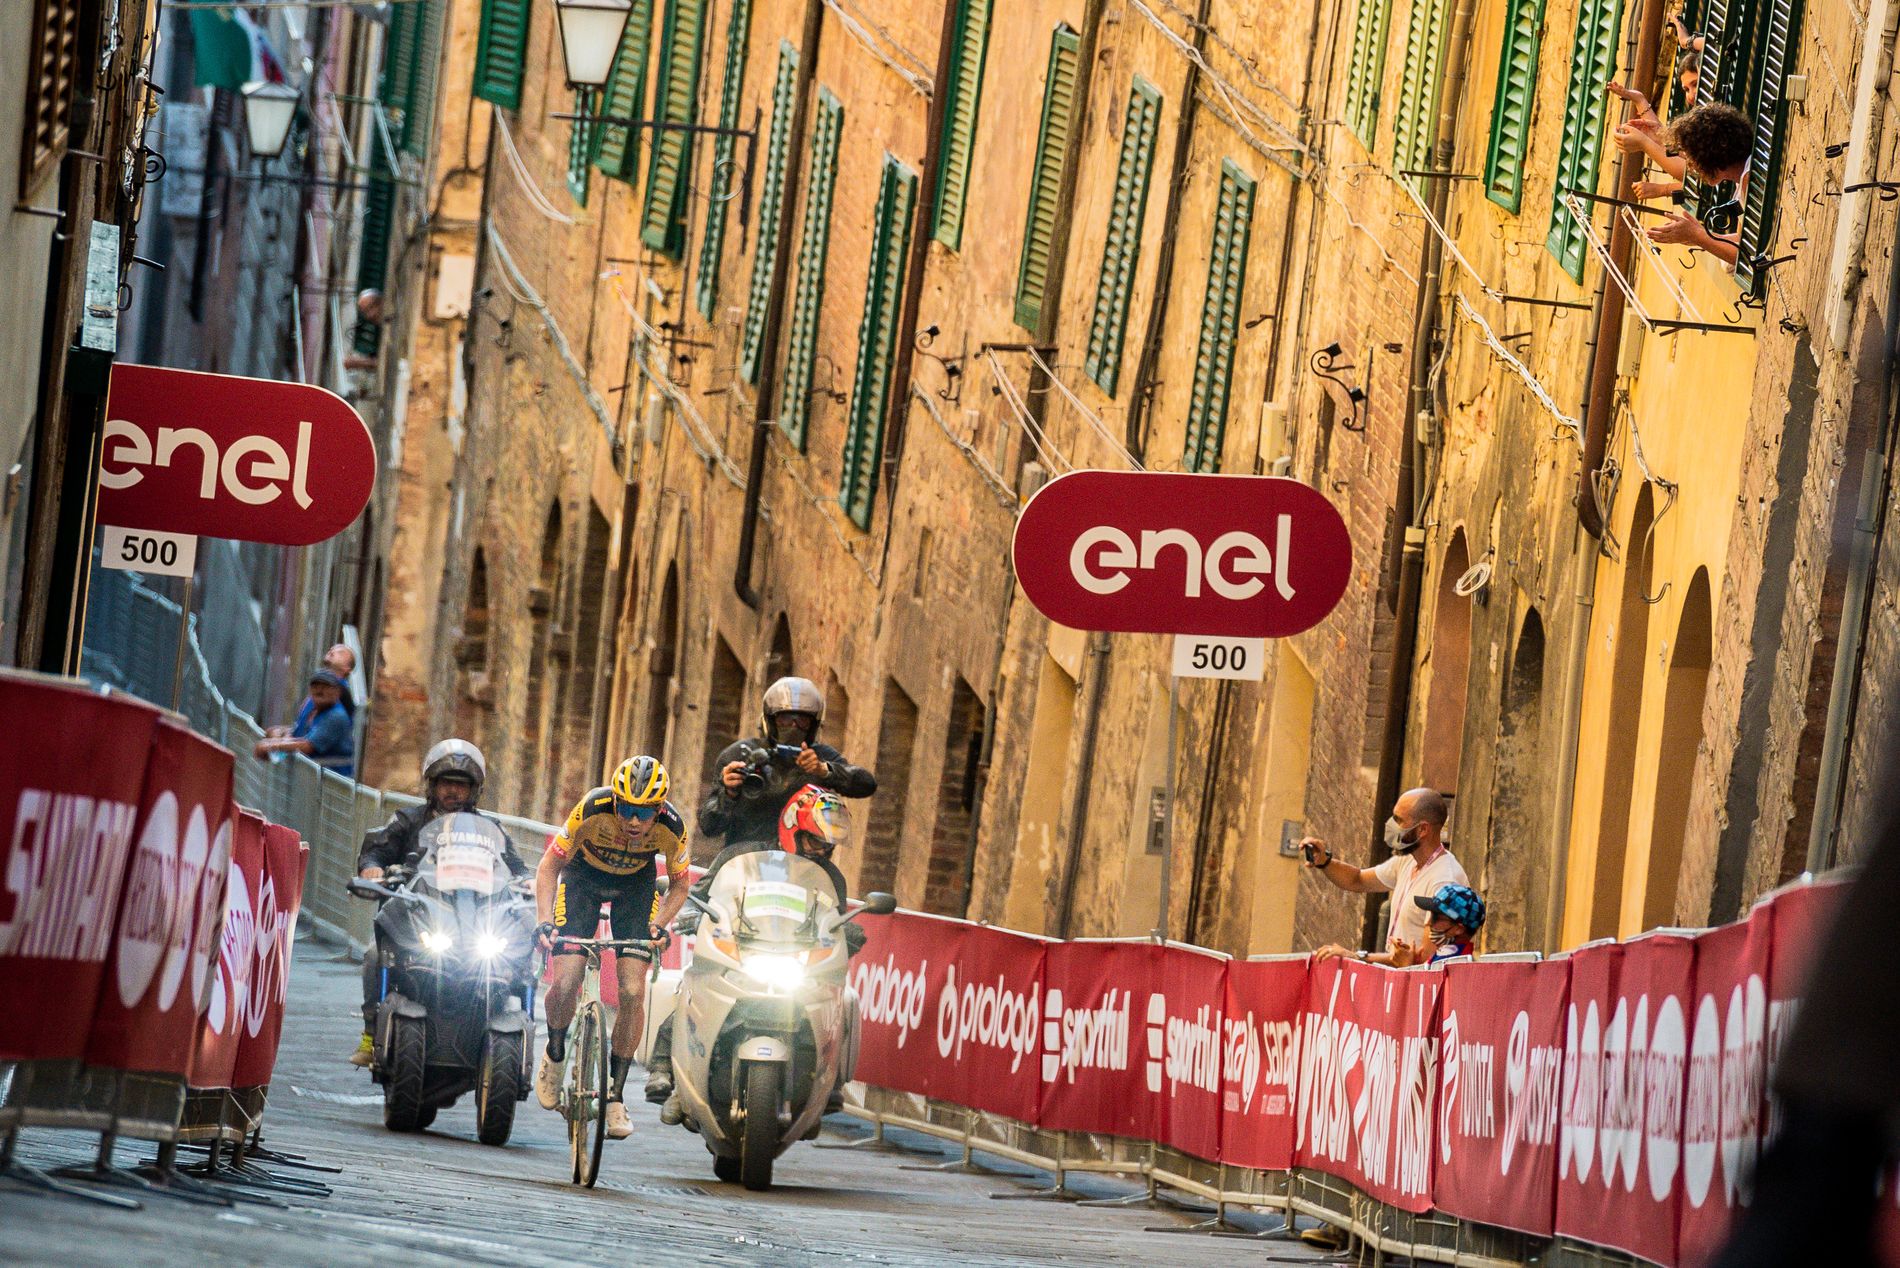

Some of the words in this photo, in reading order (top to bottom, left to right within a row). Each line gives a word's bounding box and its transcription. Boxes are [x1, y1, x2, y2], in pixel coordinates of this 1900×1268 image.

[100, 420, 313, 510] enel
[121, 535, 178, 566] 500
[1070, 513, 1296, 602] enel
[1192, 644, 1247, 671] 500
[957, 974, 1039, 1074] prologo
[1062, 988, 1131, 1084] sportful
